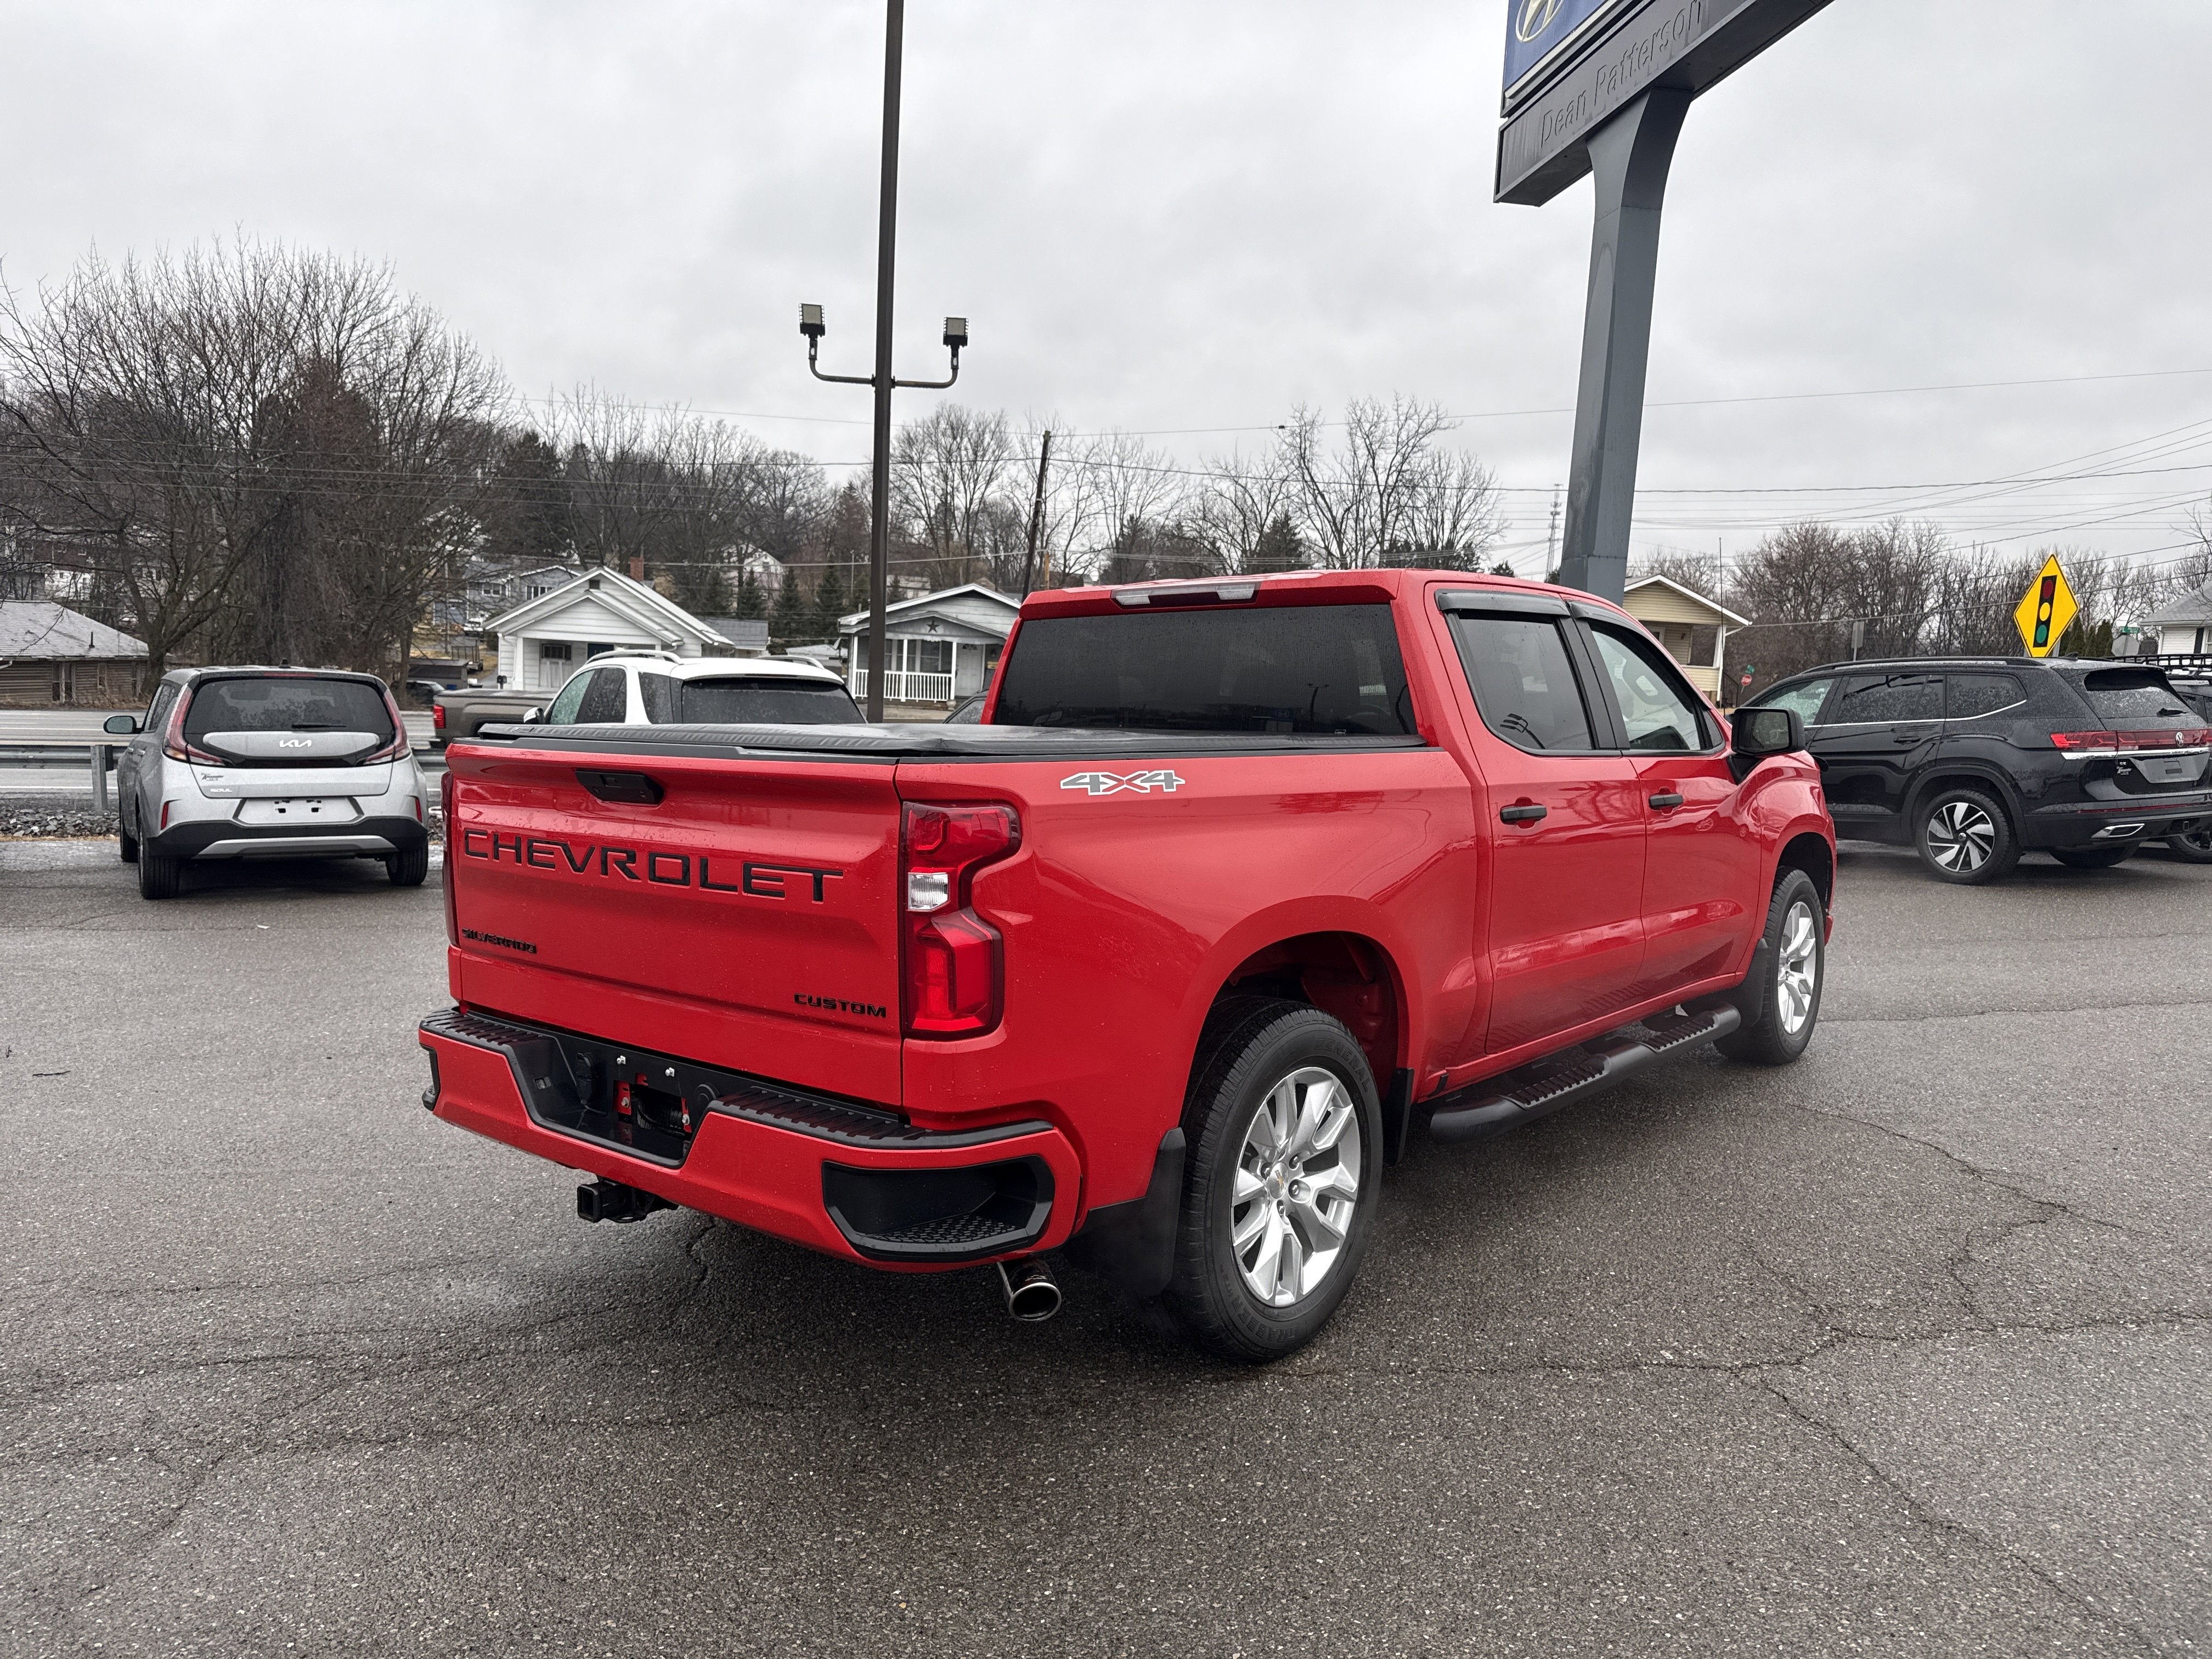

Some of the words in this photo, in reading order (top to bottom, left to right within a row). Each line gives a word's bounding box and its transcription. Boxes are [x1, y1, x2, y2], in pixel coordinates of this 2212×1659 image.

[1541, 89, 1587, 148] Dean
[1594, 0, 1701, 106] Patterson
[279, 740, 312, 748] KIA
[464, 827, 844, 905] CHEVROLET
[461, 928, 538, 954] SILVERADO
[793, 992, 887, 1018] CUSTOM
[1314, 1037, 1370, 1093] GENERAL
